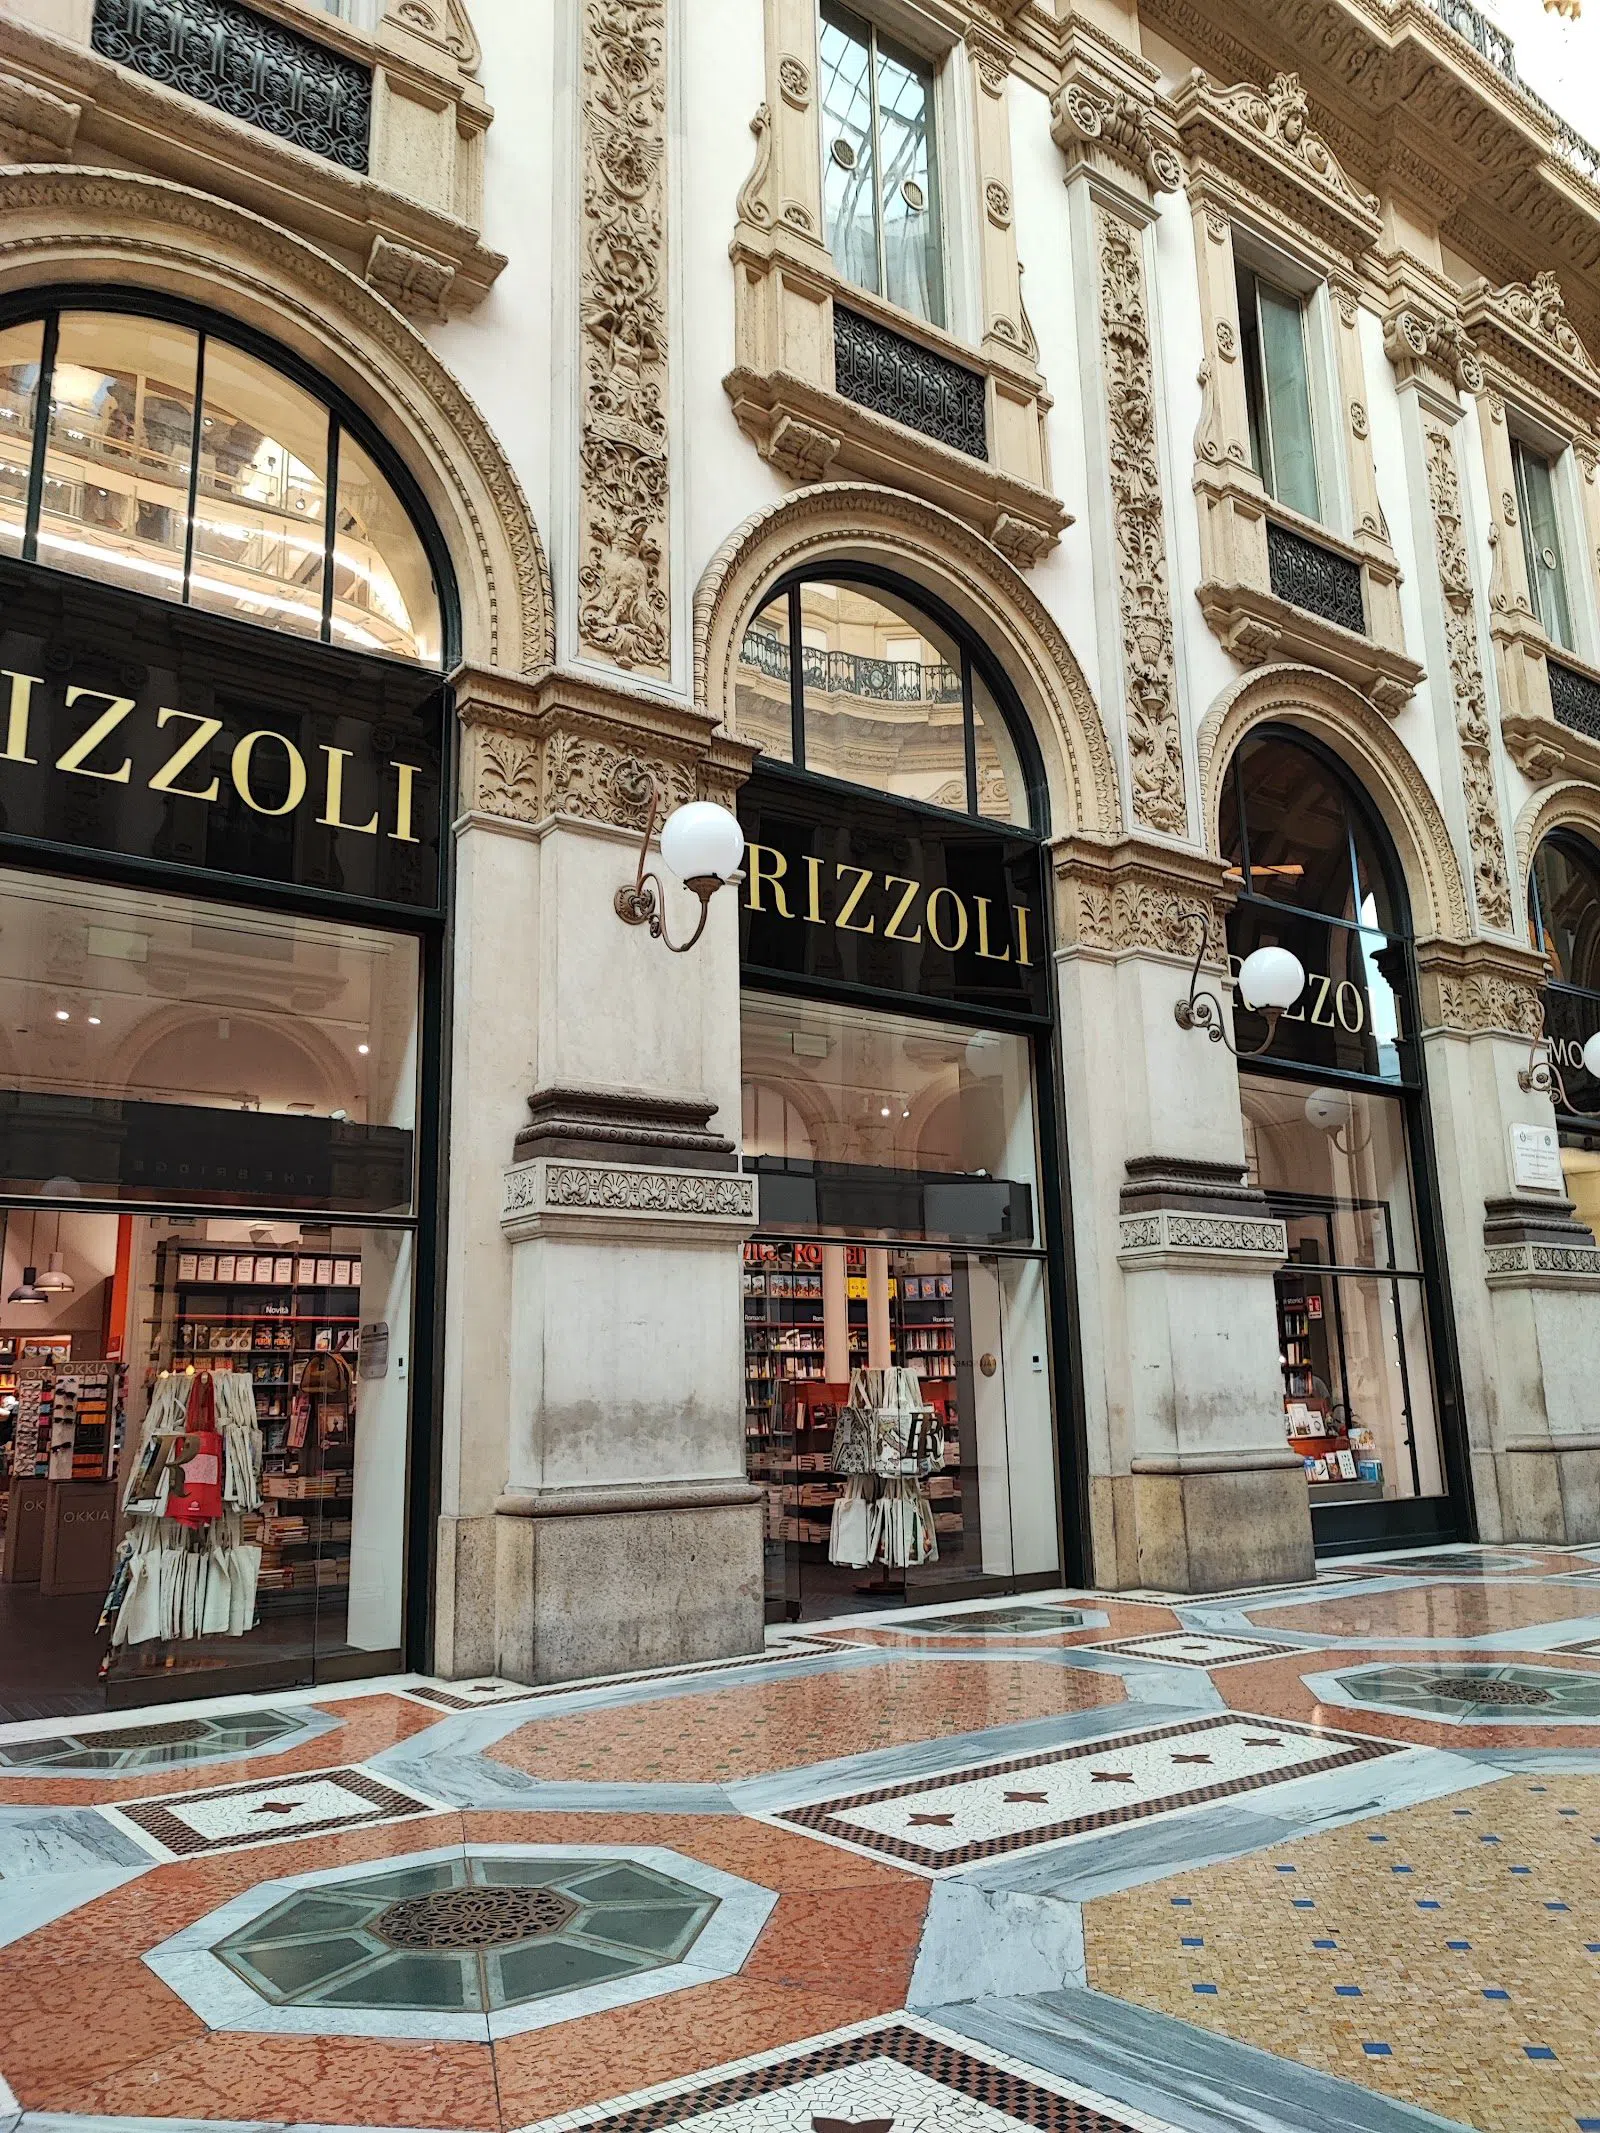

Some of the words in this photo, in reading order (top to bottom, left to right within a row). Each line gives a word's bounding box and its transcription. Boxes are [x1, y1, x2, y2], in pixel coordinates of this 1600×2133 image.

[743, 841, 1035, 967] RIZZOLI
[265, 1306, 289, 1315] Novità
[62, 1363, 110, 1376] OKKIA
[62, 1510, 111, 1524] OKKIA
